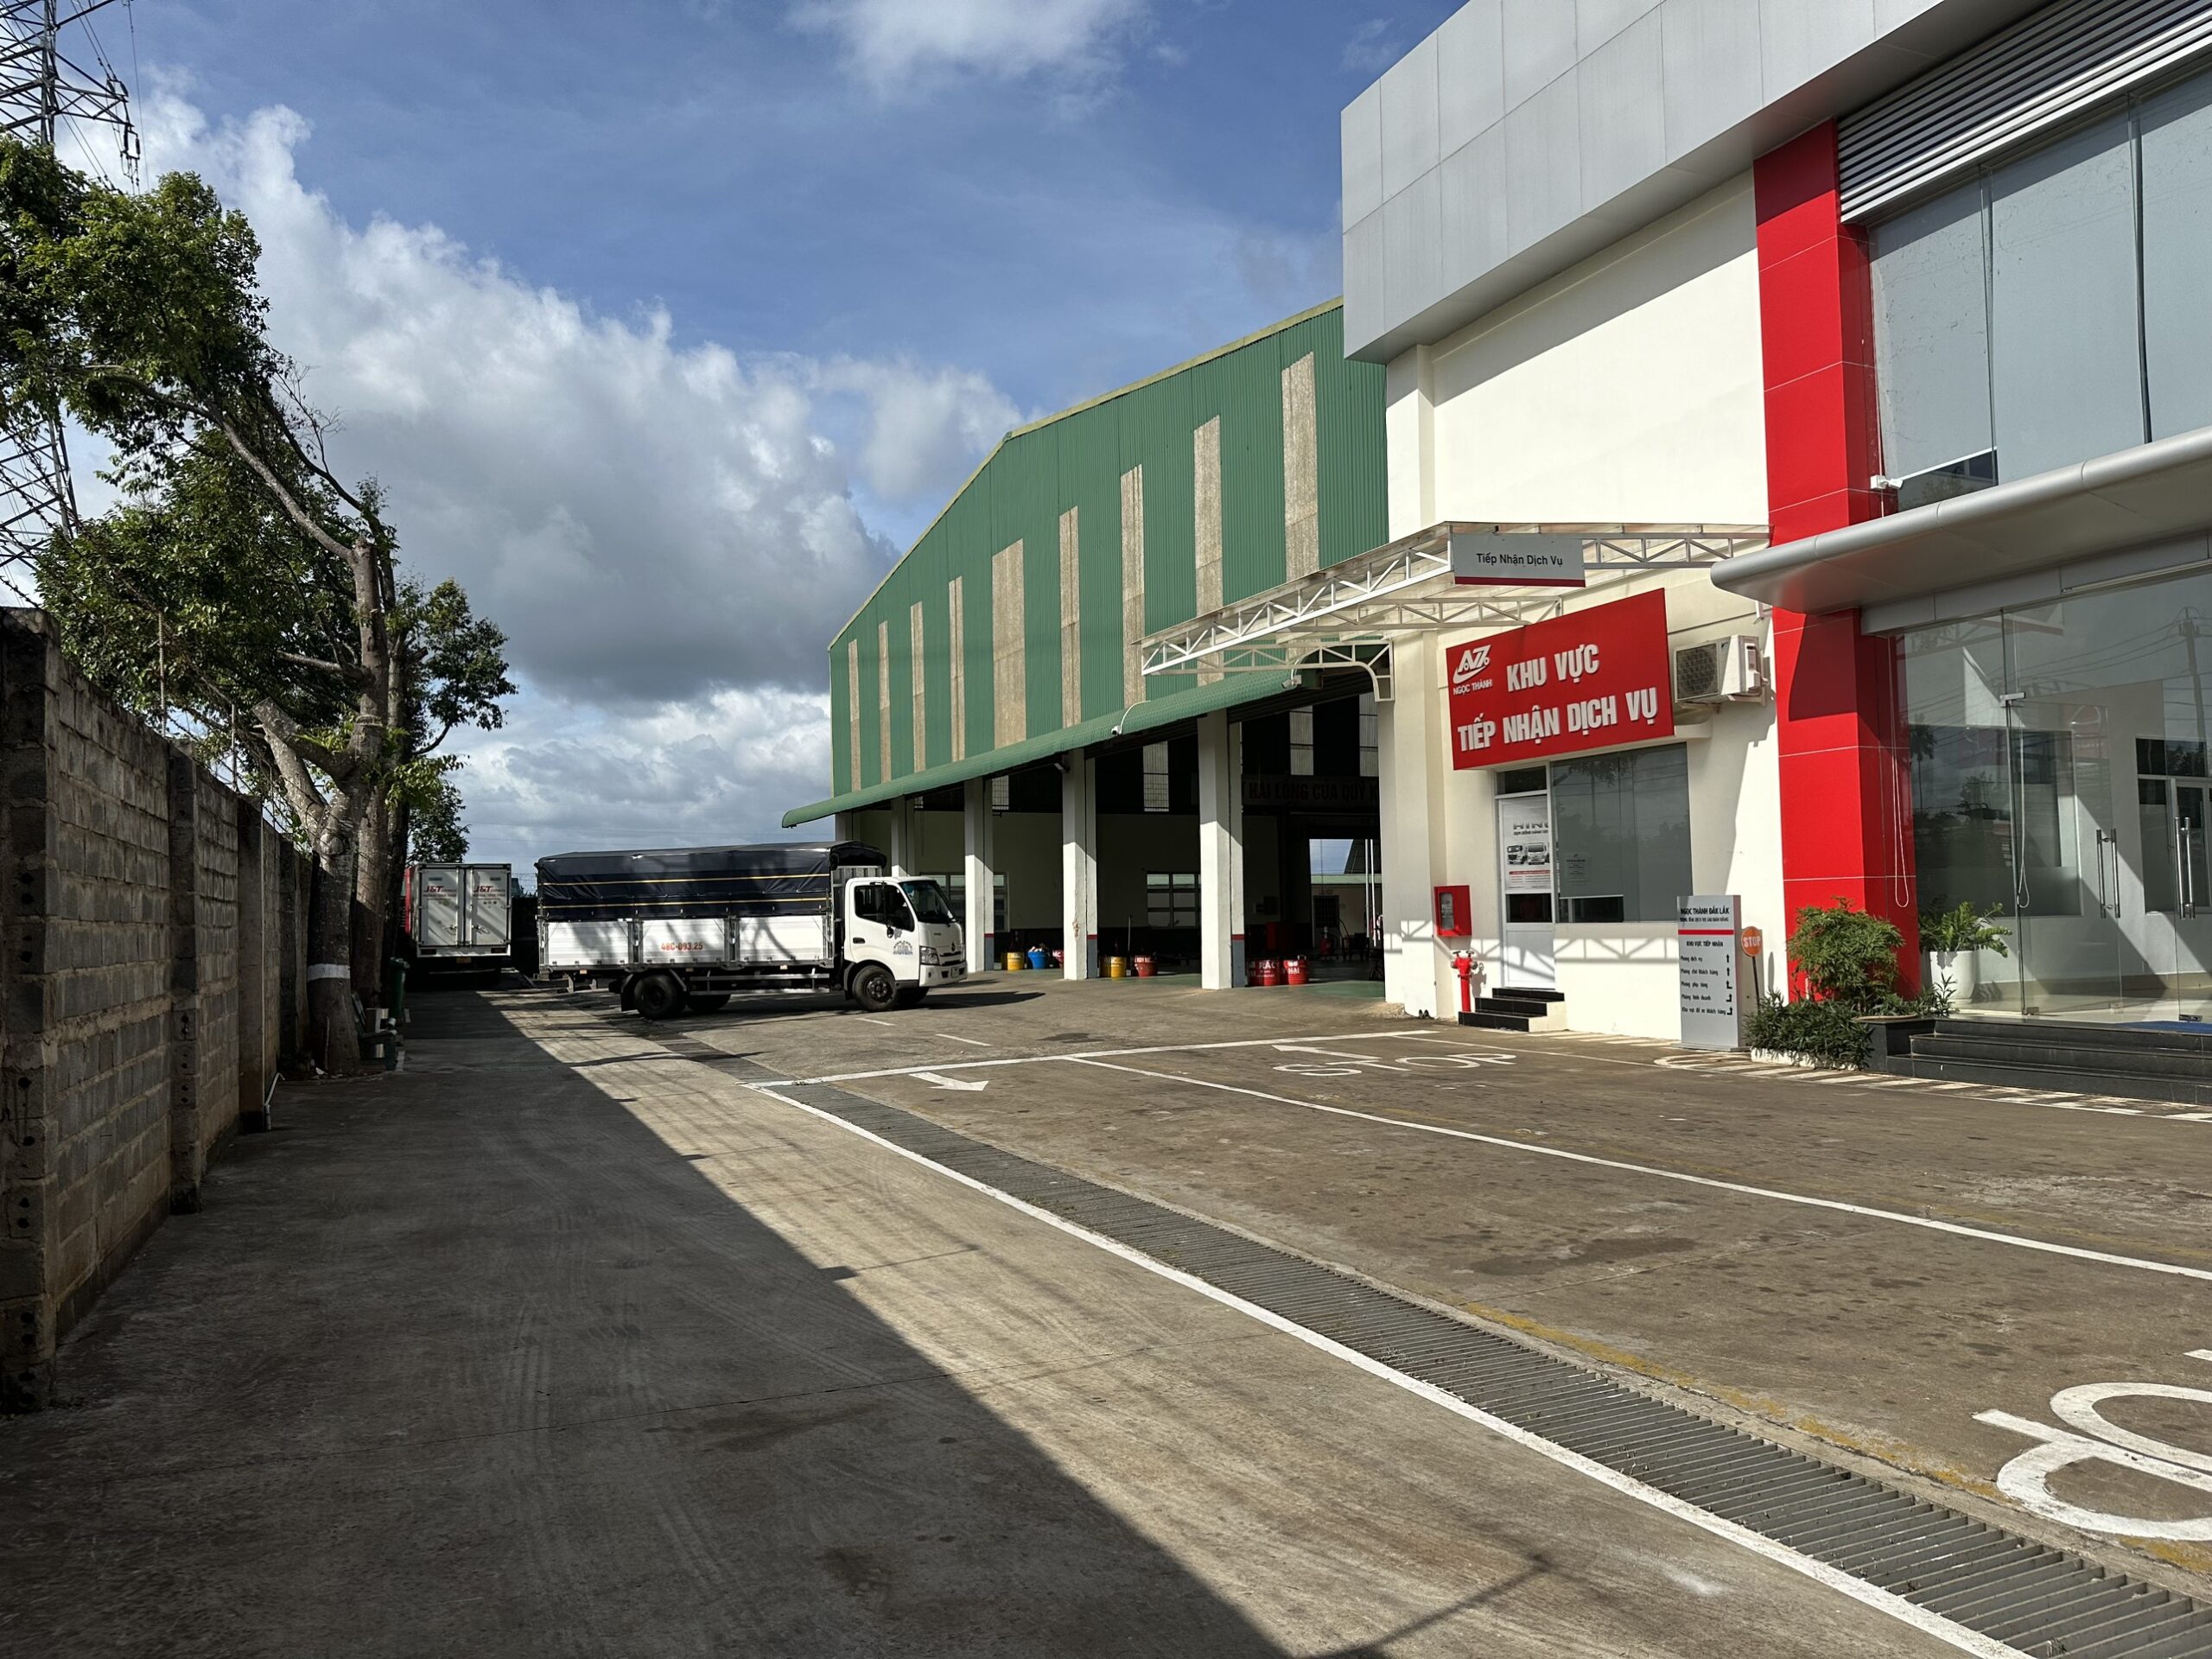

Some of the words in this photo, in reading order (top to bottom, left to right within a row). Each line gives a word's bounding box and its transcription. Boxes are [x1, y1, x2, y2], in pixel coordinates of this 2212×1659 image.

[1476, 552, 1497, 565] Tiếp
[1500, 554, 1524, 567] Nhận
[1527, 555, 1548, 567] Dịch
[1550, 556, 1563, 567] Vụ
[1506, 657, 1547, 692] KHU
[1554, 644, 1599, 683] VỰC
[1452, 683, 1470, 696] NGỌC
[1471, 678, 1493, 690] THÀNH
[1457, 713, 1497, 752] TIẾP
[1503, 704, 1560, 744] NHẬN
[1567, 695, 1618, 735] DỊCH
[1625, 687, 1658, 725] VỤ
[1743, 937, 1761, 948] STOP
[1273, 1052, 1516, 1077] STOP
